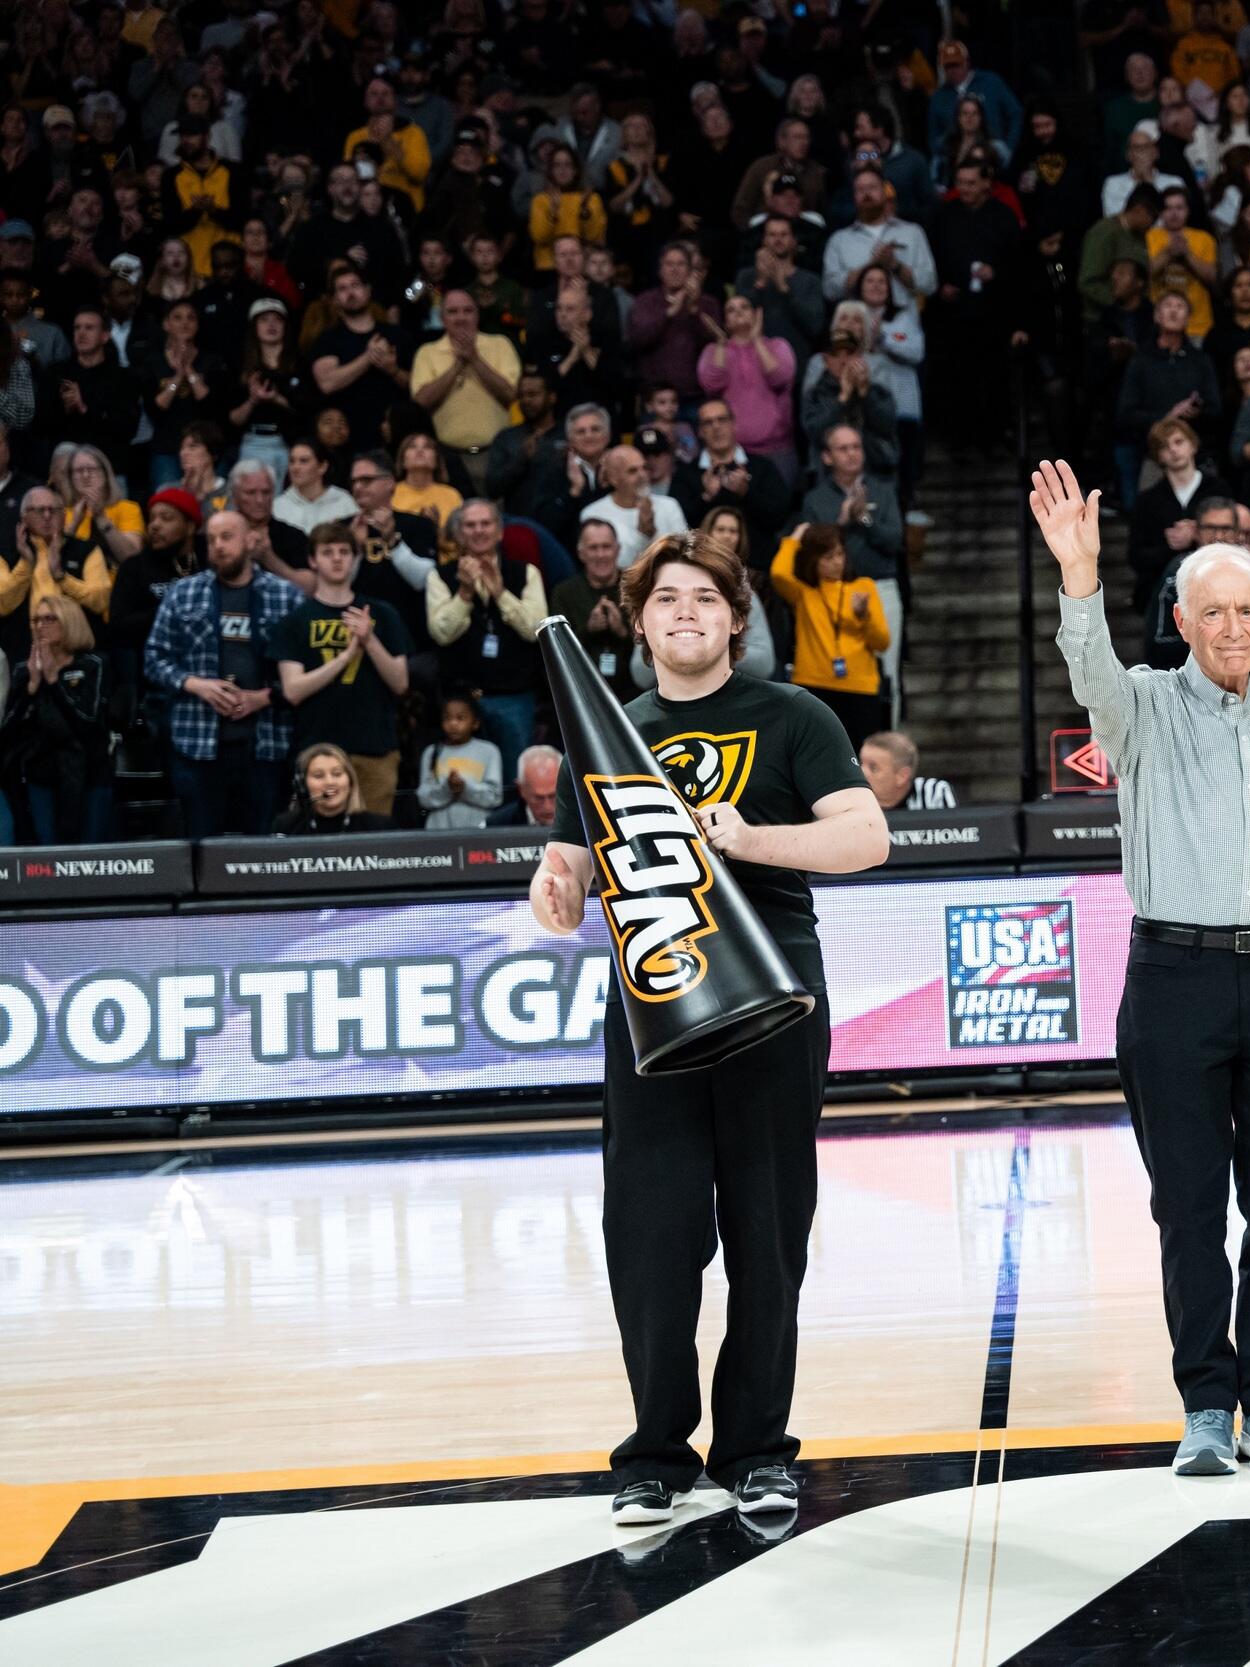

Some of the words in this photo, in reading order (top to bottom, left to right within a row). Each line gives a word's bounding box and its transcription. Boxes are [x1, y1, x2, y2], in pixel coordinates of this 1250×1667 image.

[959, 917, 1061, 969] USA
[62, 973, 219, 1067] OF
[235, 963, 460, 1059] THE
[952, 987, 1038, 1017] IRON
[958, 1012, 1069, 1046] METAL
